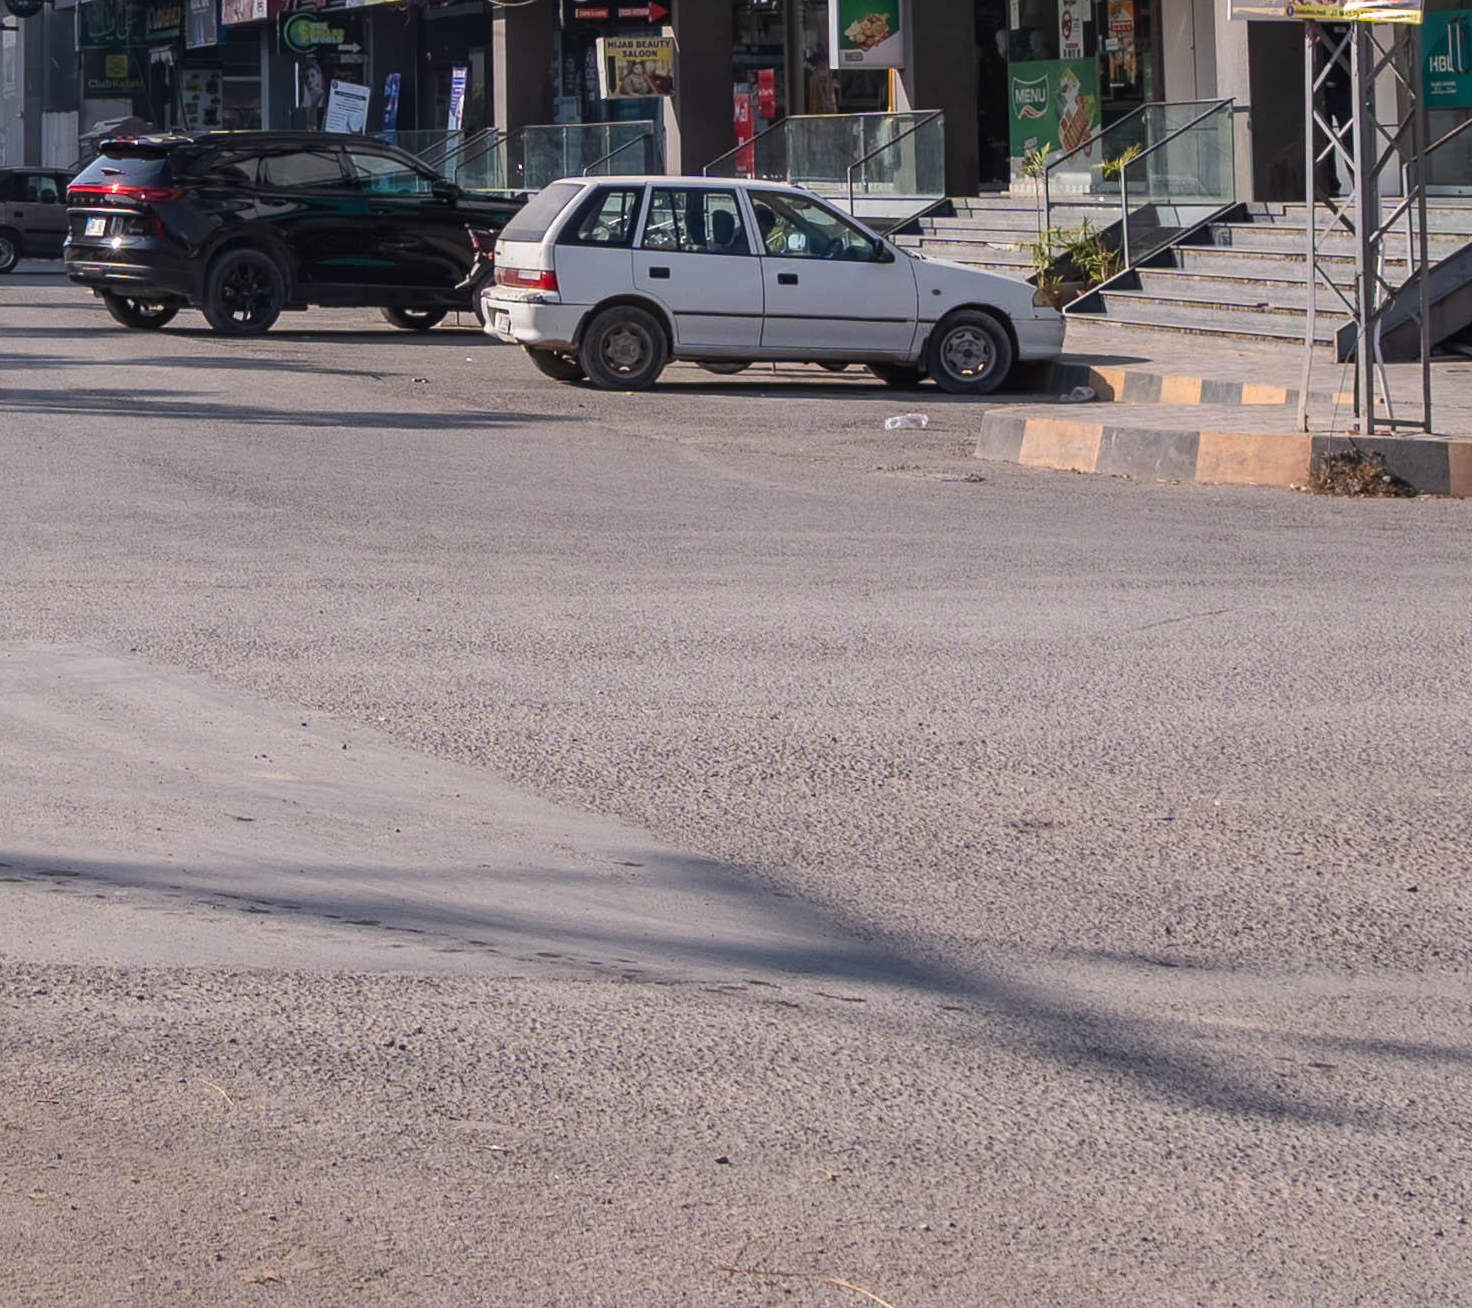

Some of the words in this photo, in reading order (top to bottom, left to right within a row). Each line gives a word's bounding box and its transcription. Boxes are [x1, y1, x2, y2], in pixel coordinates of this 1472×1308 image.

[607, 40, 634, 49] HIJAB
[637, 40, 671, 48] BEAUTY
[622, 49, 658, 57] SALOON
[1014, 88, 1046, 103] MENU
